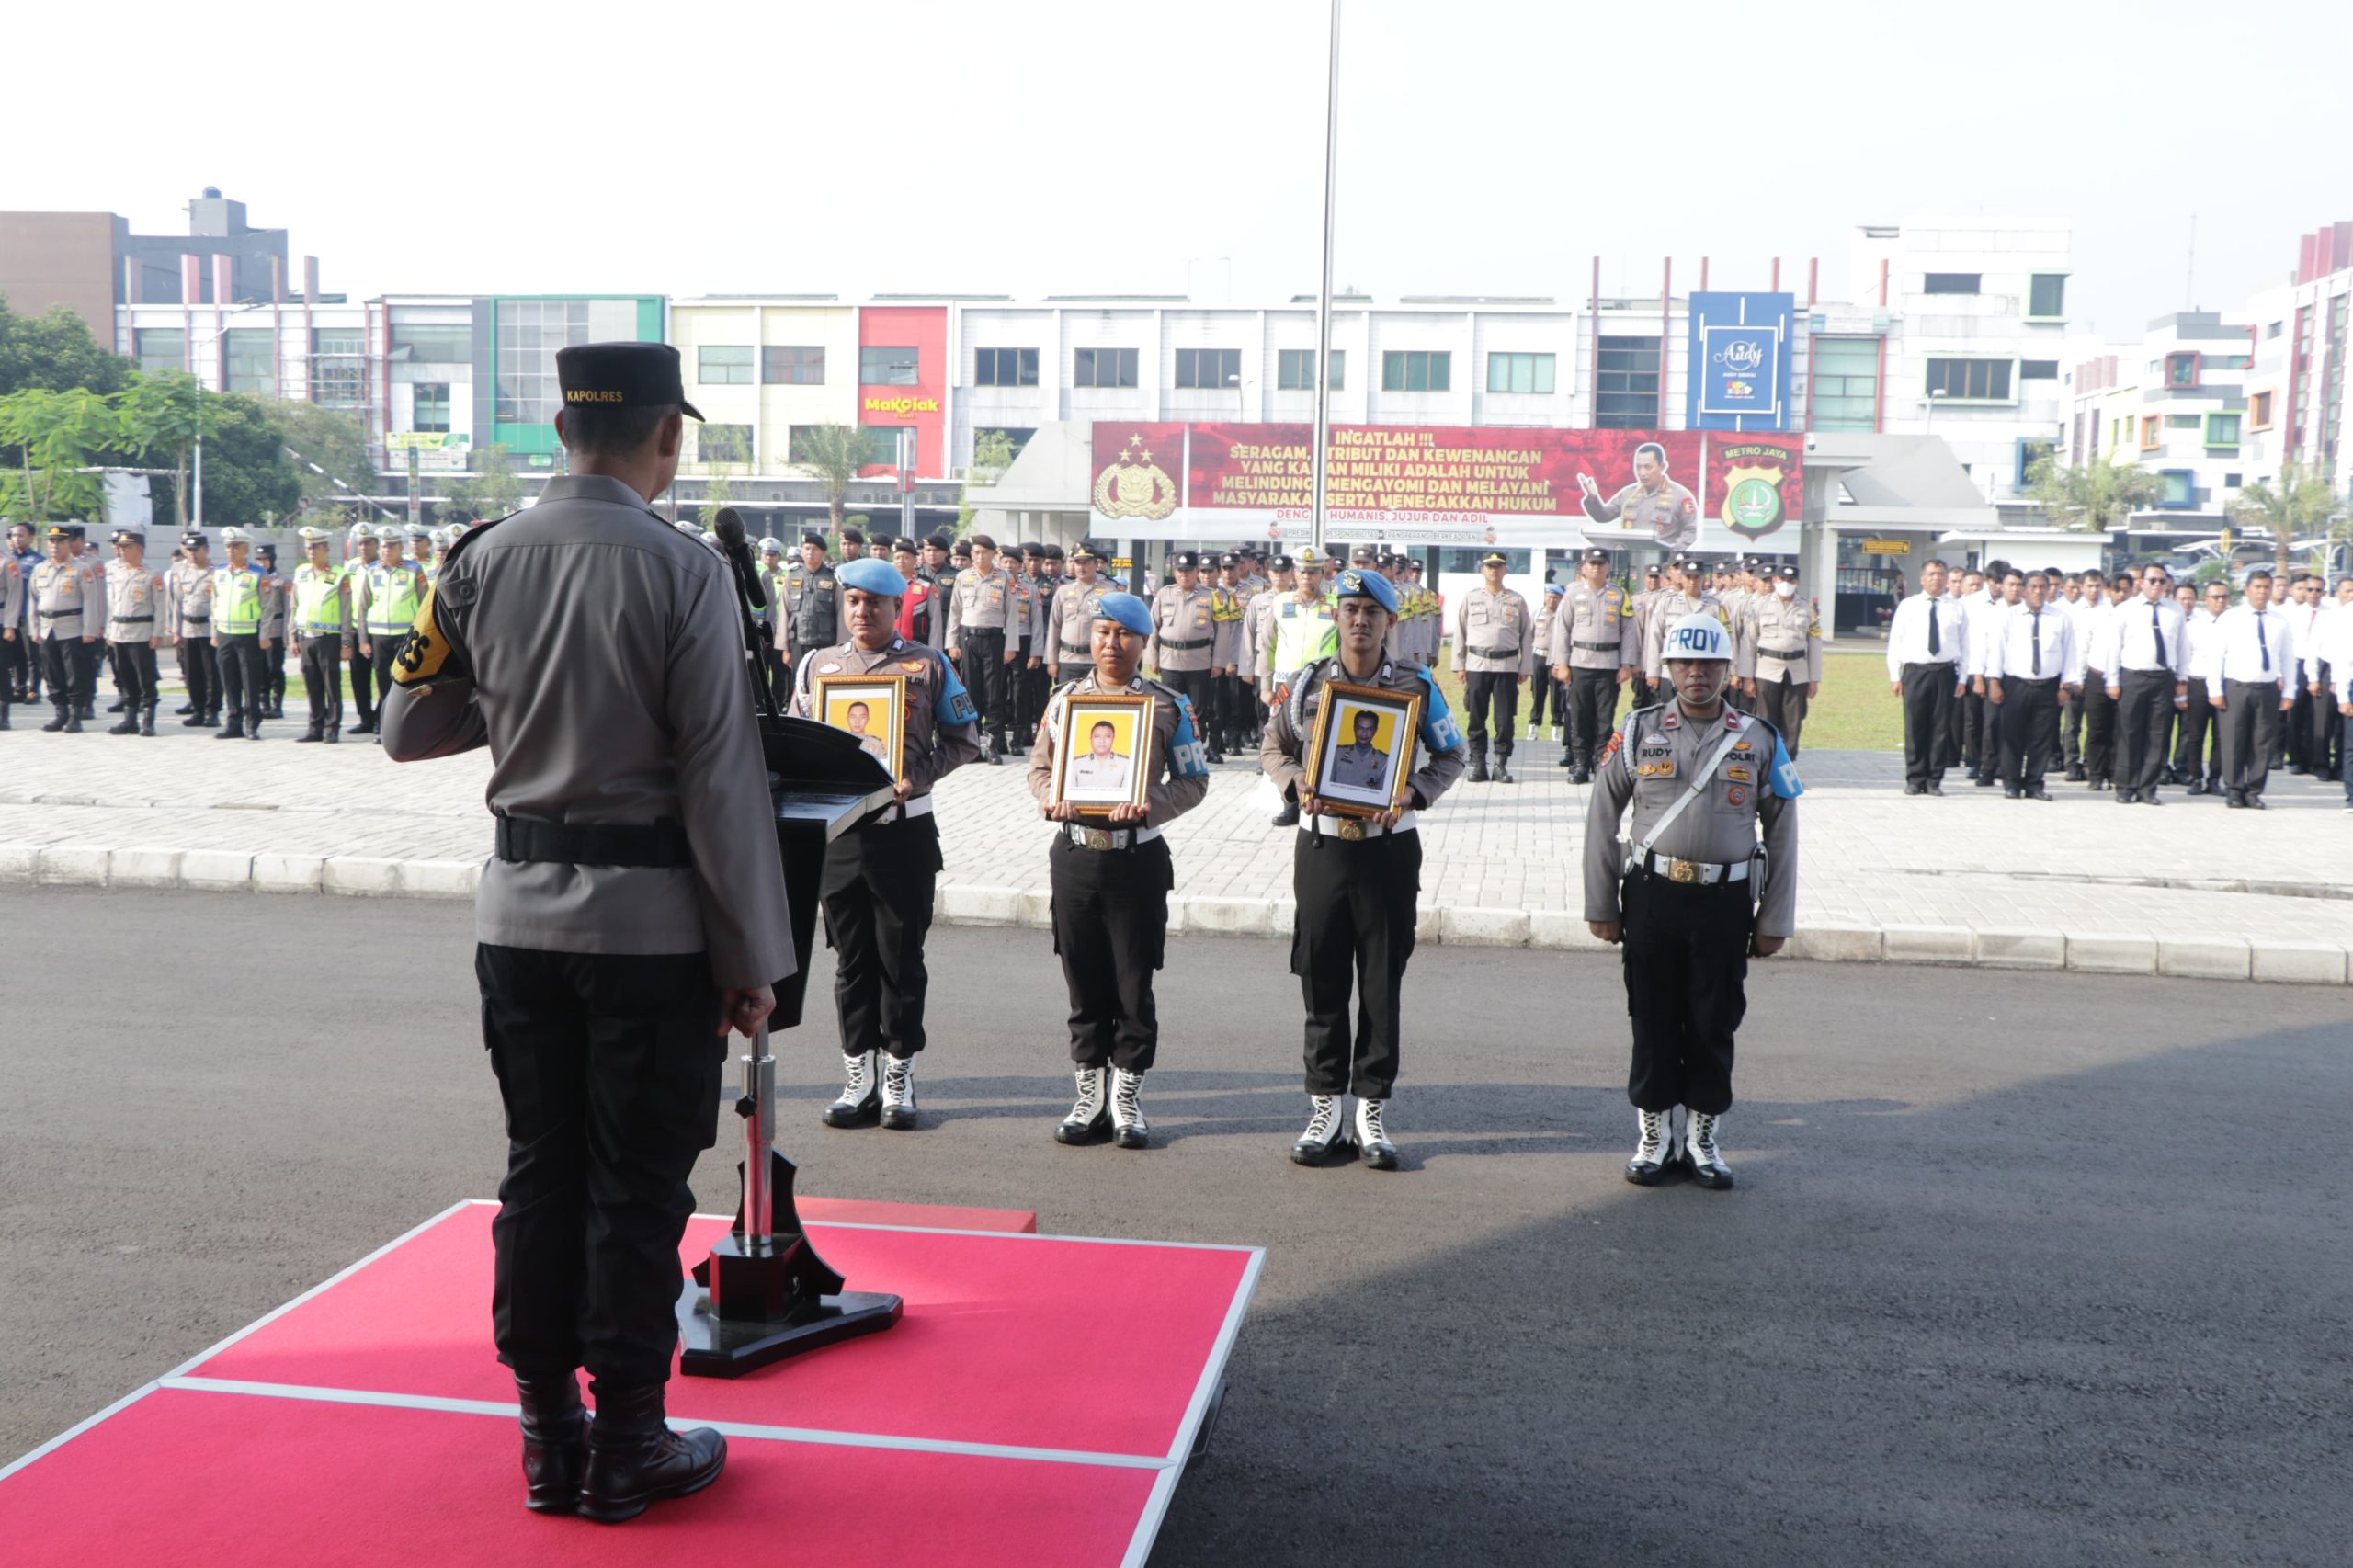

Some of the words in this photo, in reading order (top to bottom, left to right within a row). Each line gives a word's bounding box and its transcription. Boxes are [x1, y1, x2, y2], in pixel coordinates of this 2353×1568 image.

[566, 390, 623, 402] KAPOLRES
[1336, 431, 1415, 446] INGATLAH
[1230, 445, 1311, 460] SERAGAM,
[1326, 447, 1382, 460] TRIBUT
[1386, 448, 1419, 461] DAN
[1424, 449, 1541, 464] KEWENANGAN
[1725, 447, 1761, 459] METRO
[1763, 447, 1787, 460] JAYA
[1241, 461, 1284, 474] YANG
[1288, 461, 1347, 475] KAAN
[1351, 463, 1400, 476] MILIKI
[1404, 463, 1471, 478] ADALAH
[1474, 465, 1529, 479] UNTUK
[1222, 476, 1313, 490] MELINDUNG
[1327, 478, 1424, 493] MENGAYOMI
[1428, 480, 1461, 493] DAN
[1466, 481, 1549, 494] MELAYANI
[1213, 491, 1313, 506] MASYARAKA
[1326, 493, 1375, 506] SERTA
[1380, 494, 1495, 509] MENEGAKKAN
[1498, 496, 1557, 511] HUKUM
[1277, 509, 1312, 519] DENG
[1392, 511, 1428, 522] JUJUR
[1432, 512, 1458, 522] DAN
[1461, 513, 1488, 523] ADIL
[1667, 627, 1721, 653] PROV
[1642, 748, 1672, 758] RUDY
